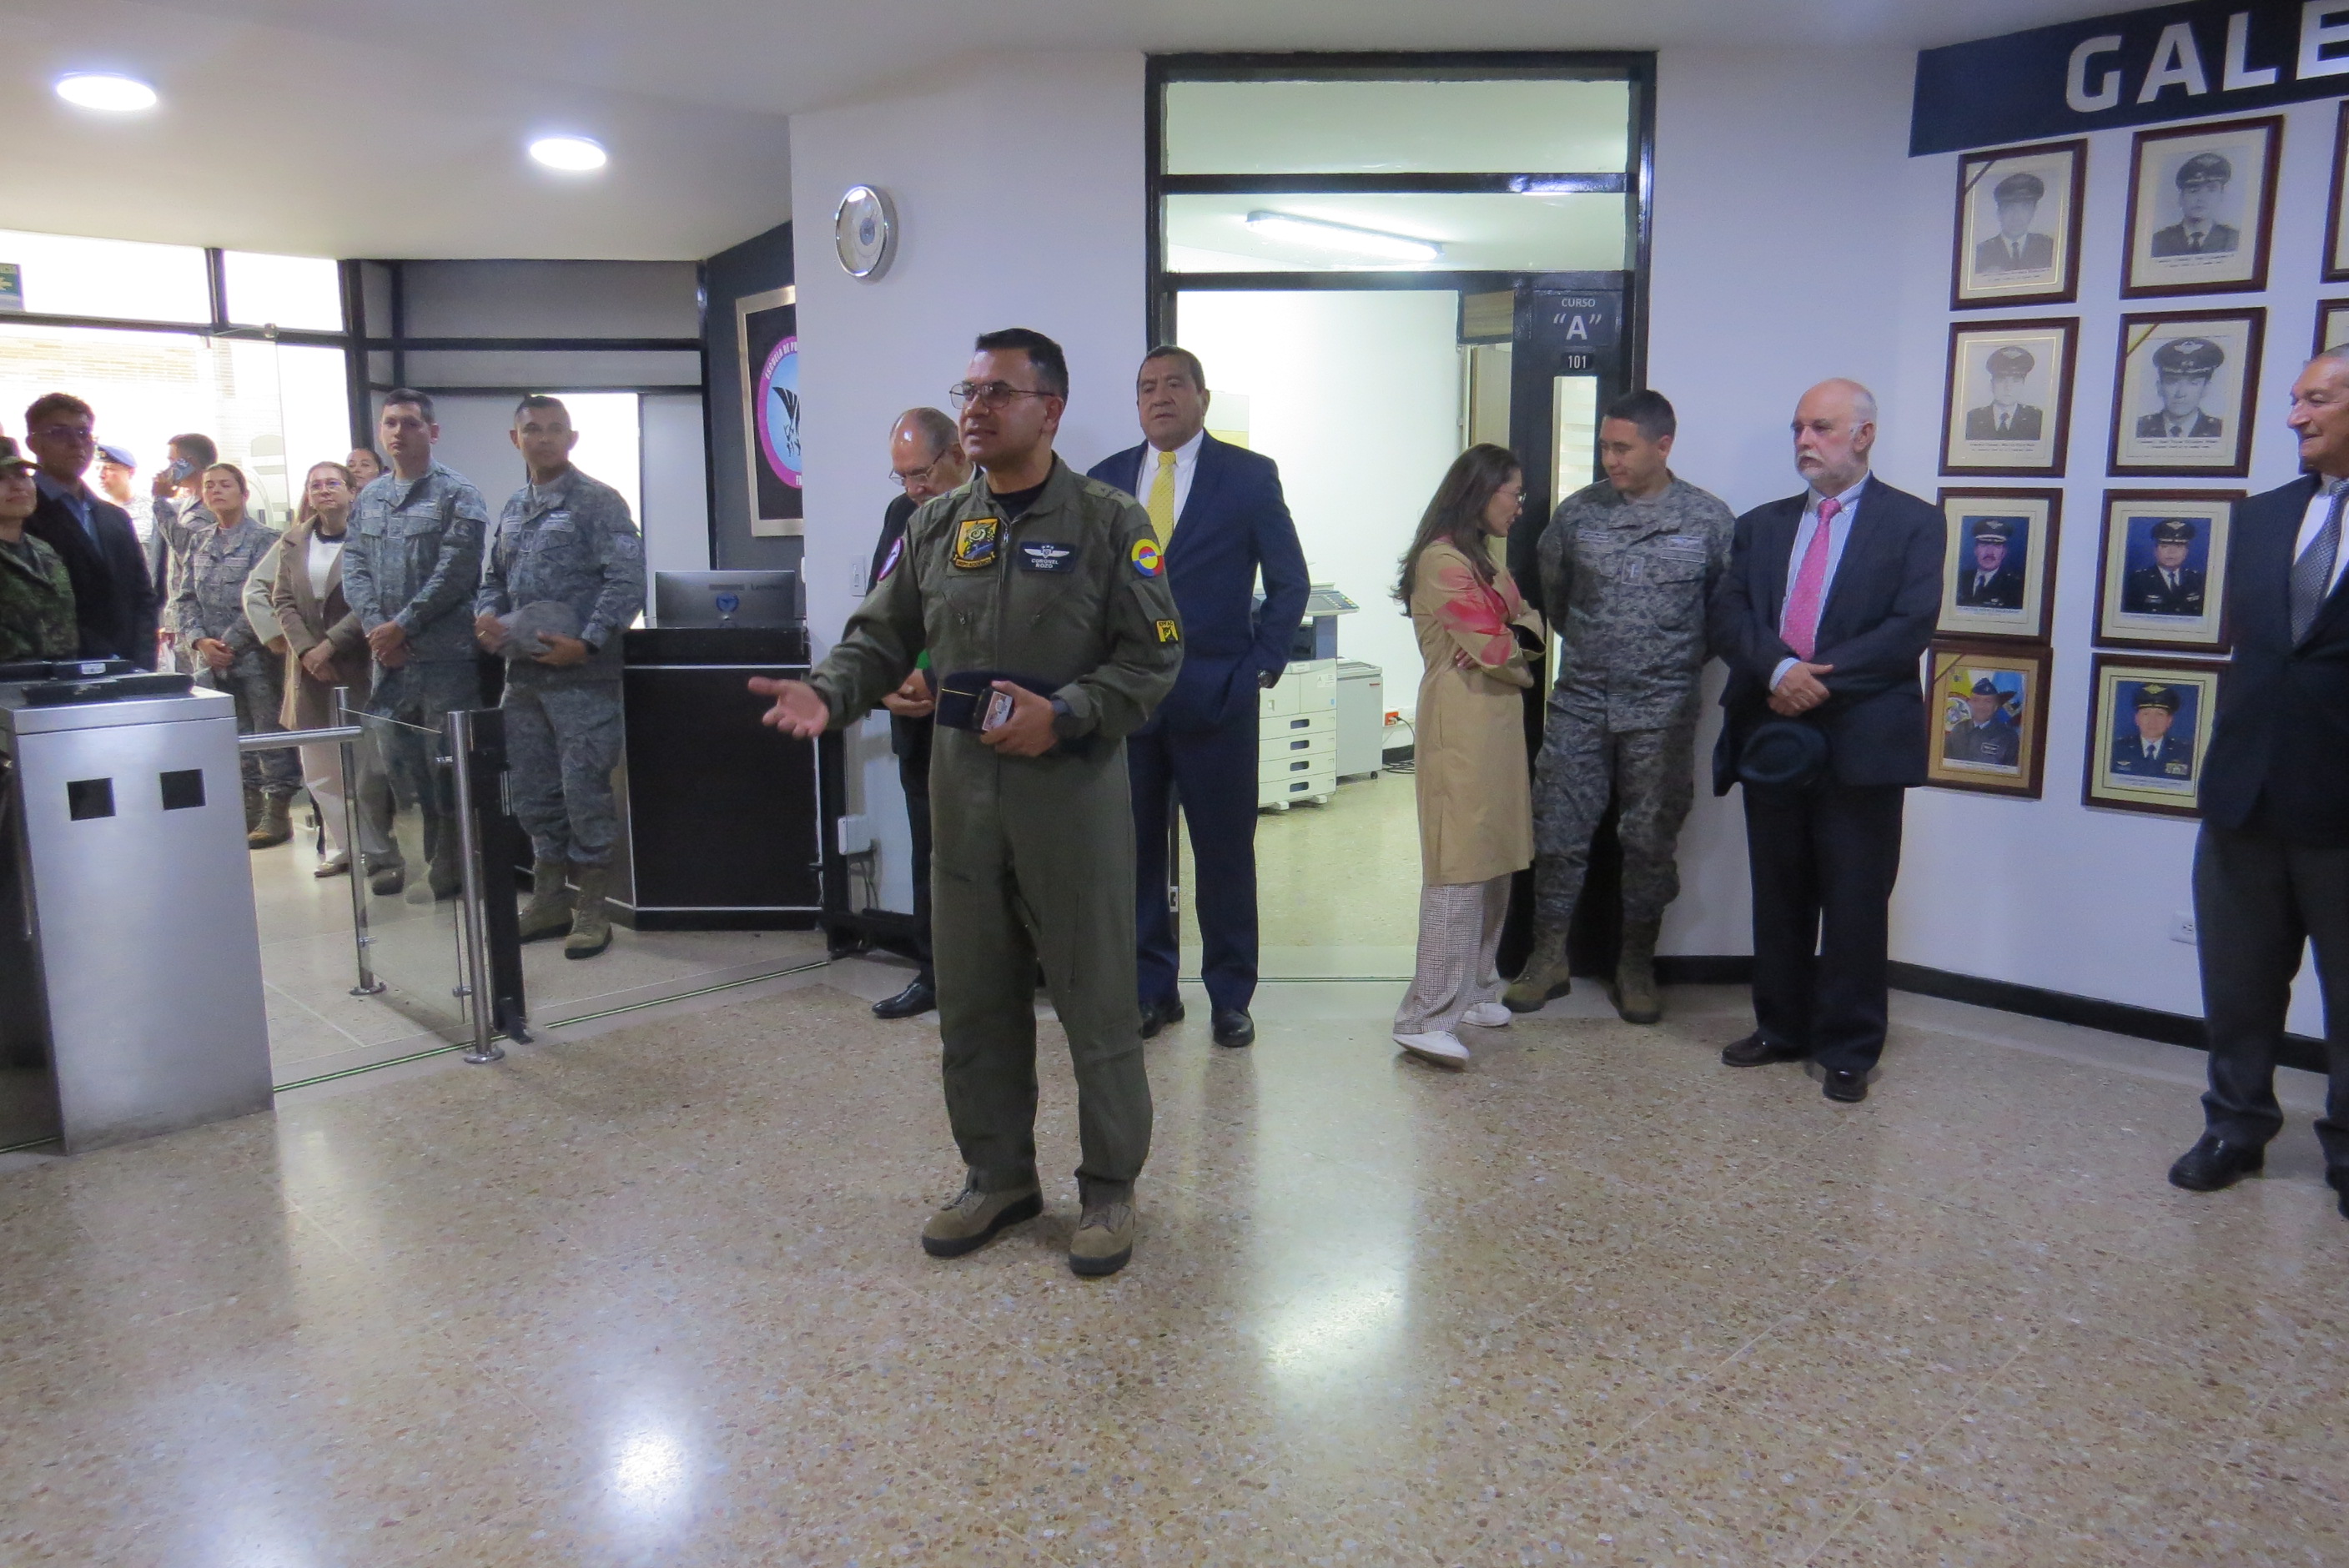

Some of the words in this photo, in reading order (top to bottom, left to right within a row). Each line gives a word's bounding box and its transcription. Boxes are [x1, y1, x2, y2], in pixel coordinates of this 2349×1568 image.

[1562, 298, 1596, 308] CURSO
[765, 348, 783, 380] ESCUELA
[782, 343, 790, 354] DE
[1568, 355, 1587, 369] 101
